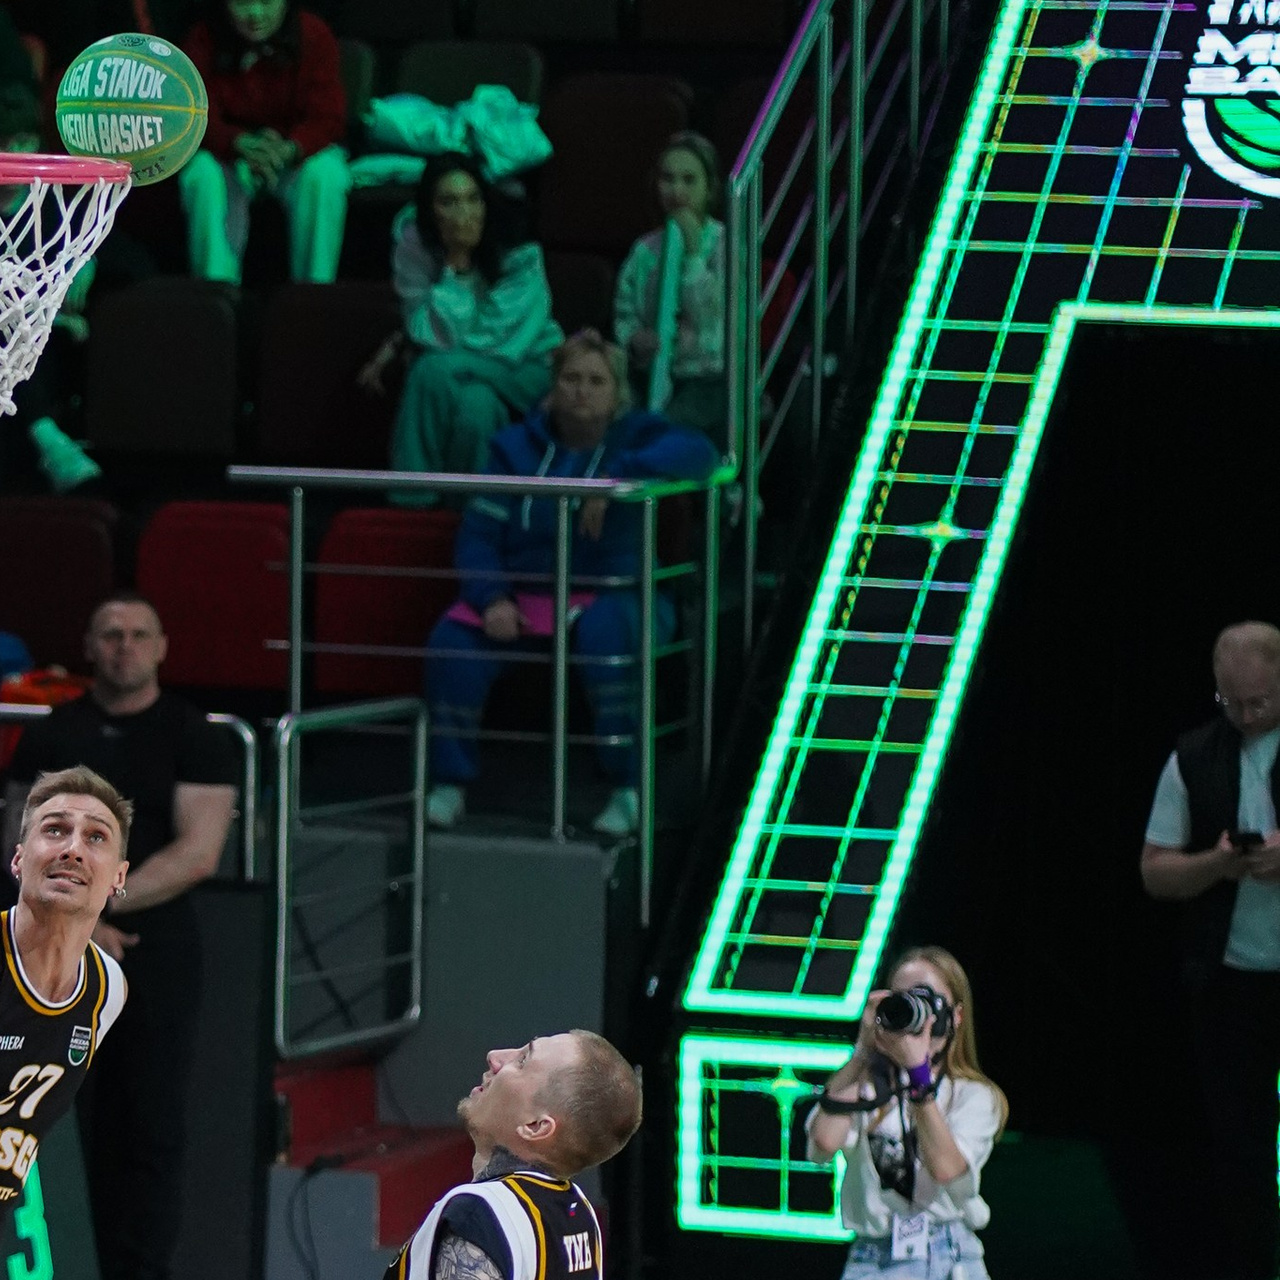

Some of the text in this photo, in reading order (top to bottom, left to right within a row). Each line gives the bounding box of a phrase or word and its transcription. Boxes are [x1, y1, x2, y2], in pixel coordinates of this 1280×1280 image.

[63, 57, 167, 100] LIGA STAVOK
[62, 113, 163, 154] MEDIA BASKET
